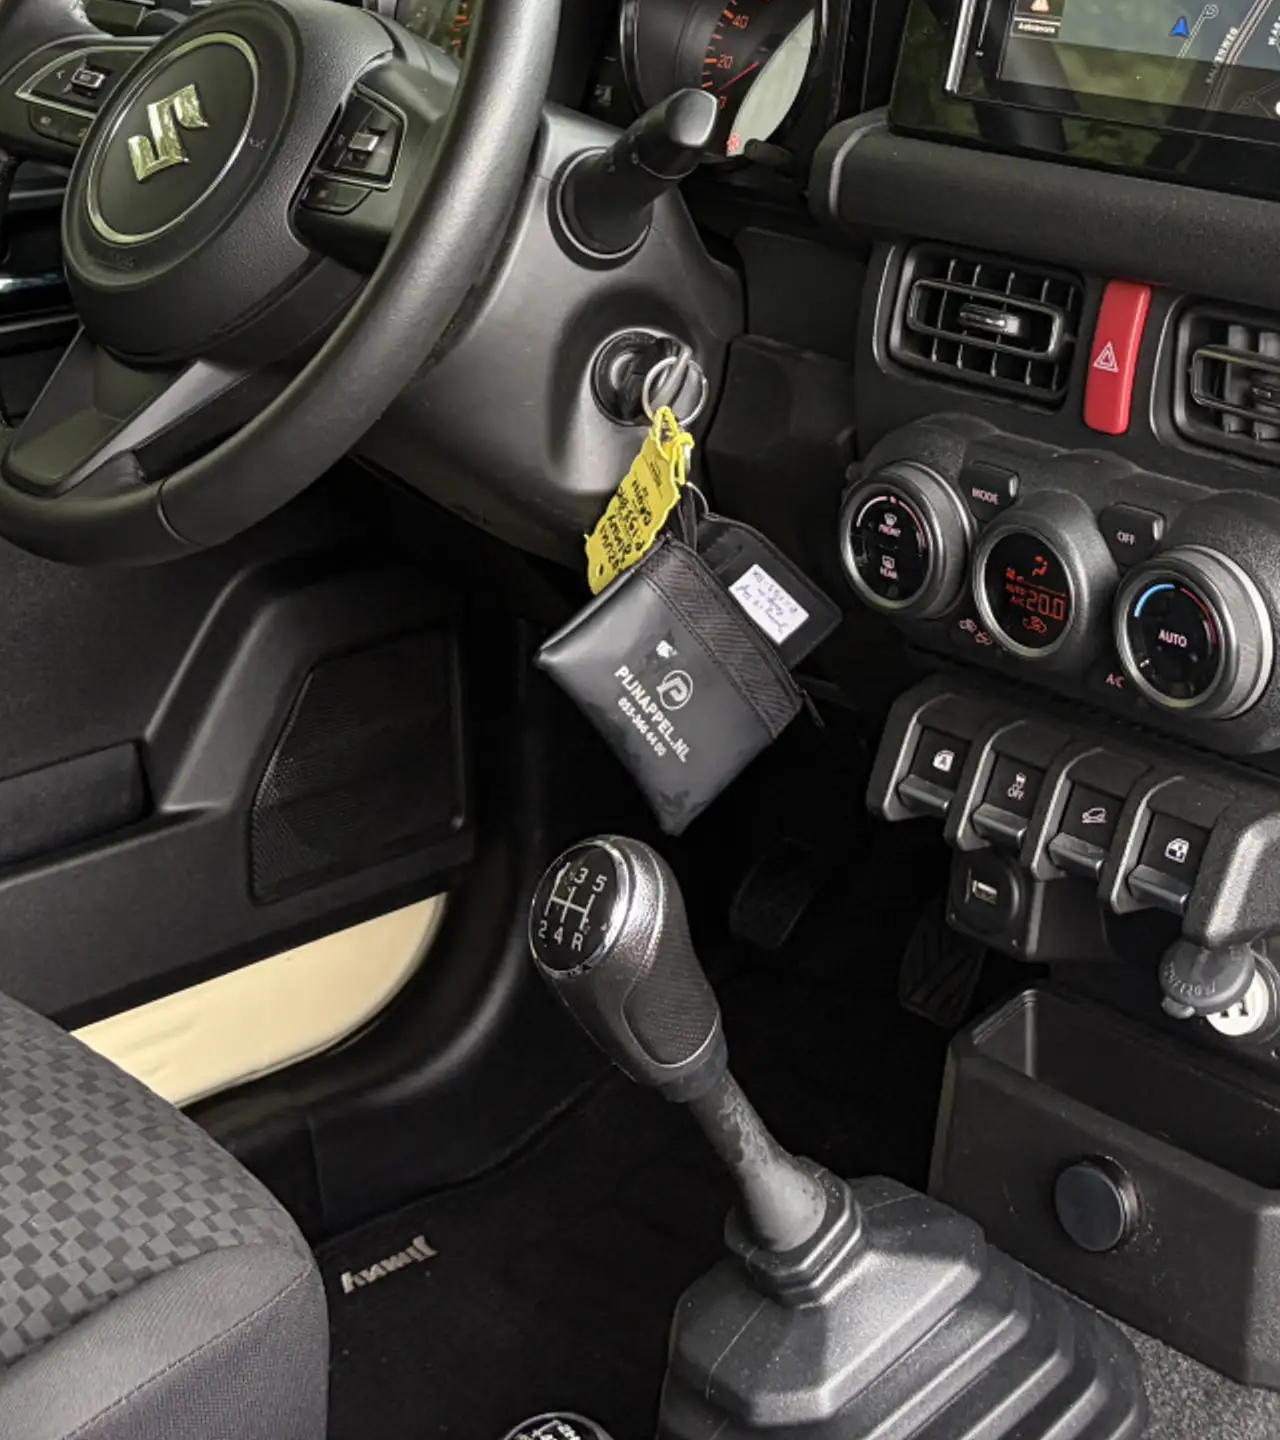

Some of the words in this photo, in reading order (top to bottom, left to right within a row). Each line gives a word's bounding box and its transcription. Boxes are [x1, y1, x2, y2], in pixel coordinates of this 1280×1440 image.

[971, 486, 999, 507] MODE
[1116, 531, 1137, 546] OFF
[1158, 628, 1188, 649] AUTO
[1105, 673, 1126, 689] A/C
[1007, 783, 1026, 801] OFF
[574, 866, 589, 884] 3
[592, 873, 608, 892] 5
[538, 919, 548, 939] 2
[553, 925, 564, 945] 4
[571, 931, 584, 952] R
